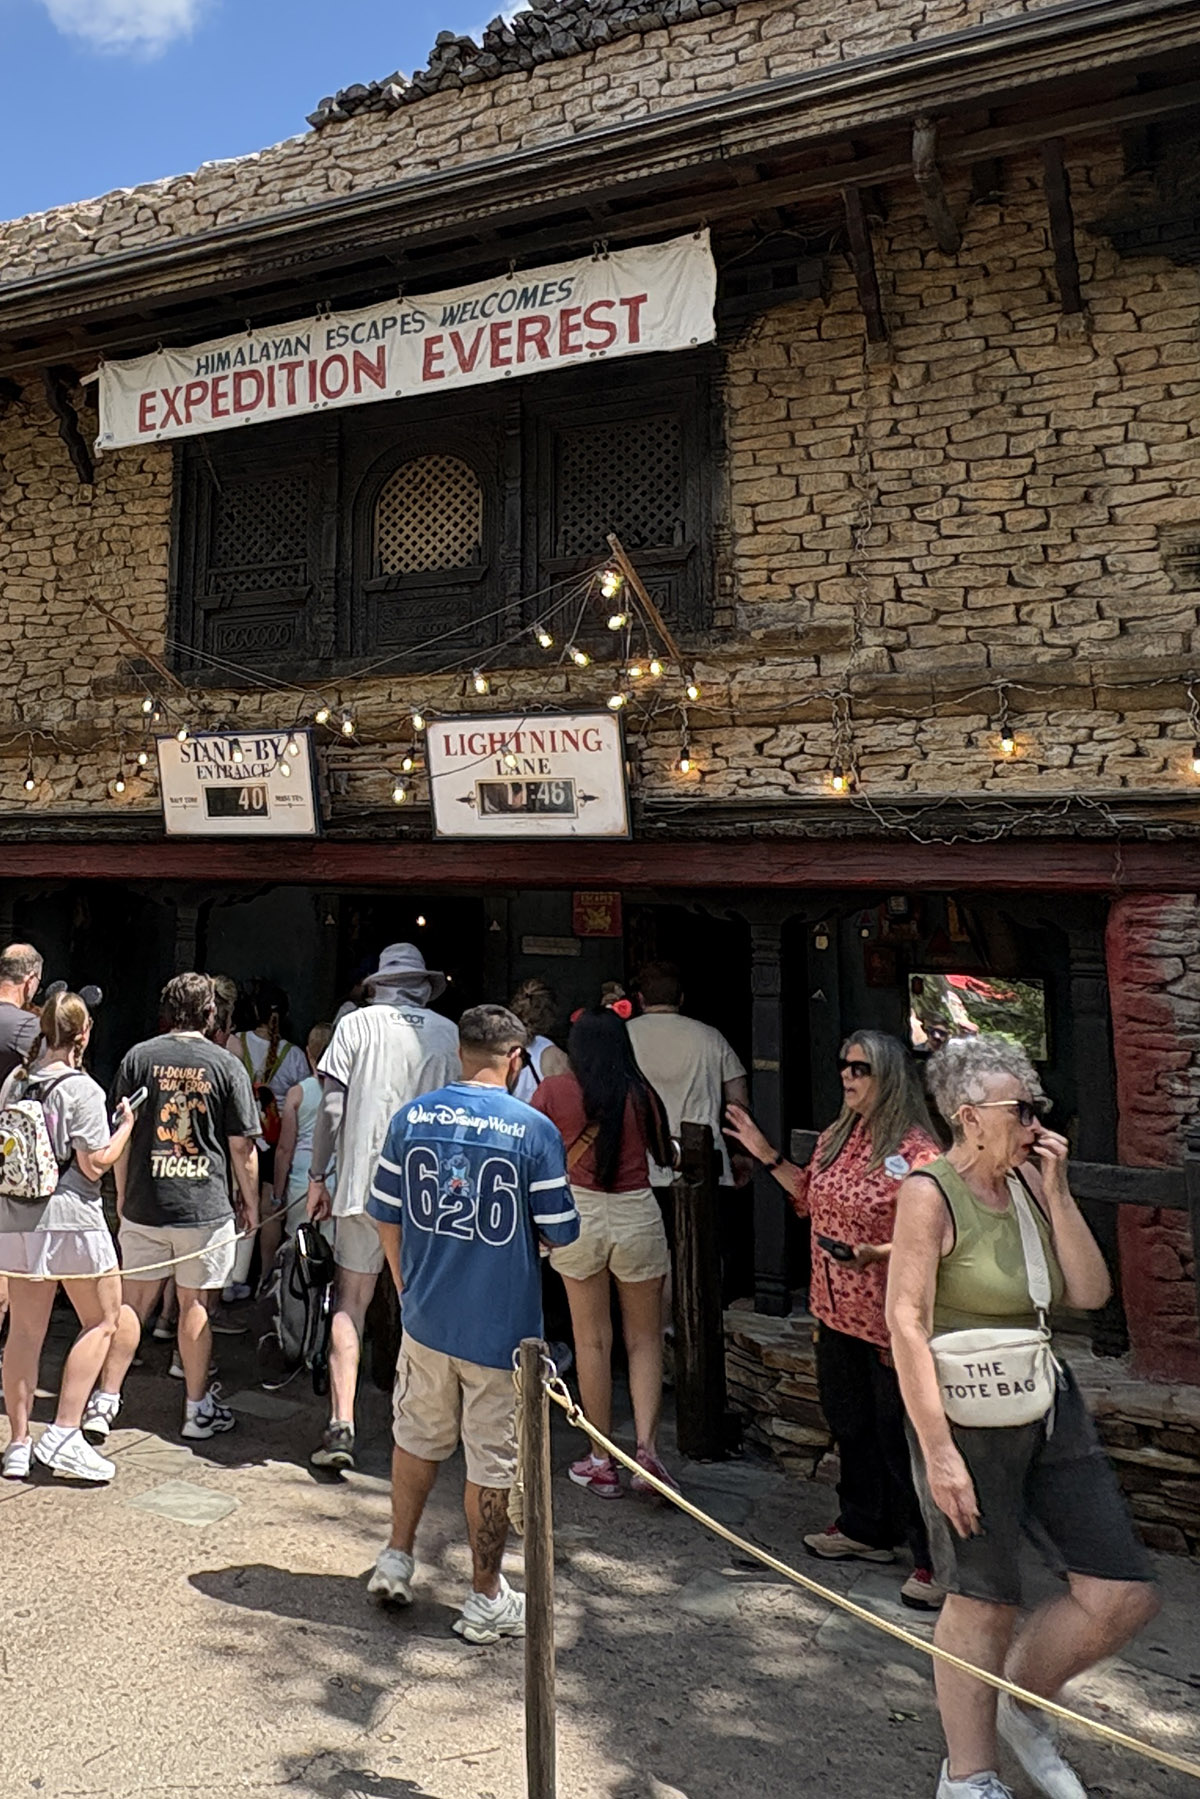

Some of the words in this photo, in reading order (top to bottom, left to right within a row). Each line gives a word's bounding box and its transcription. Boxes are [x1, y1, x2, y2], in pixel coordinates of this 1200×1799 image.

[195, 334, 310, 377] HIMALAYAN
[326, 310, 425, 350] ESCAPES
[440, 277, 576, 327] WELCOMES
[139, 344, 386, 432] EXPEDITION
[422, 293, 647, 381] EVEREST
[443, 728, 602, 757] LIGHTNING
[196, 763, 270, 779] ENTRANCE
[238, 787, 264, 810] 40
[488, 1116, 525, 1138] World
[151, 1155, 211, 1178] TIGGER
[405, 1146, 518, 1246] 626
[963, 1361, 1006, 1379] THE
[944, 1384, 991, 1399] TOTE
[997, 1379, 1036, 1396] BAG
